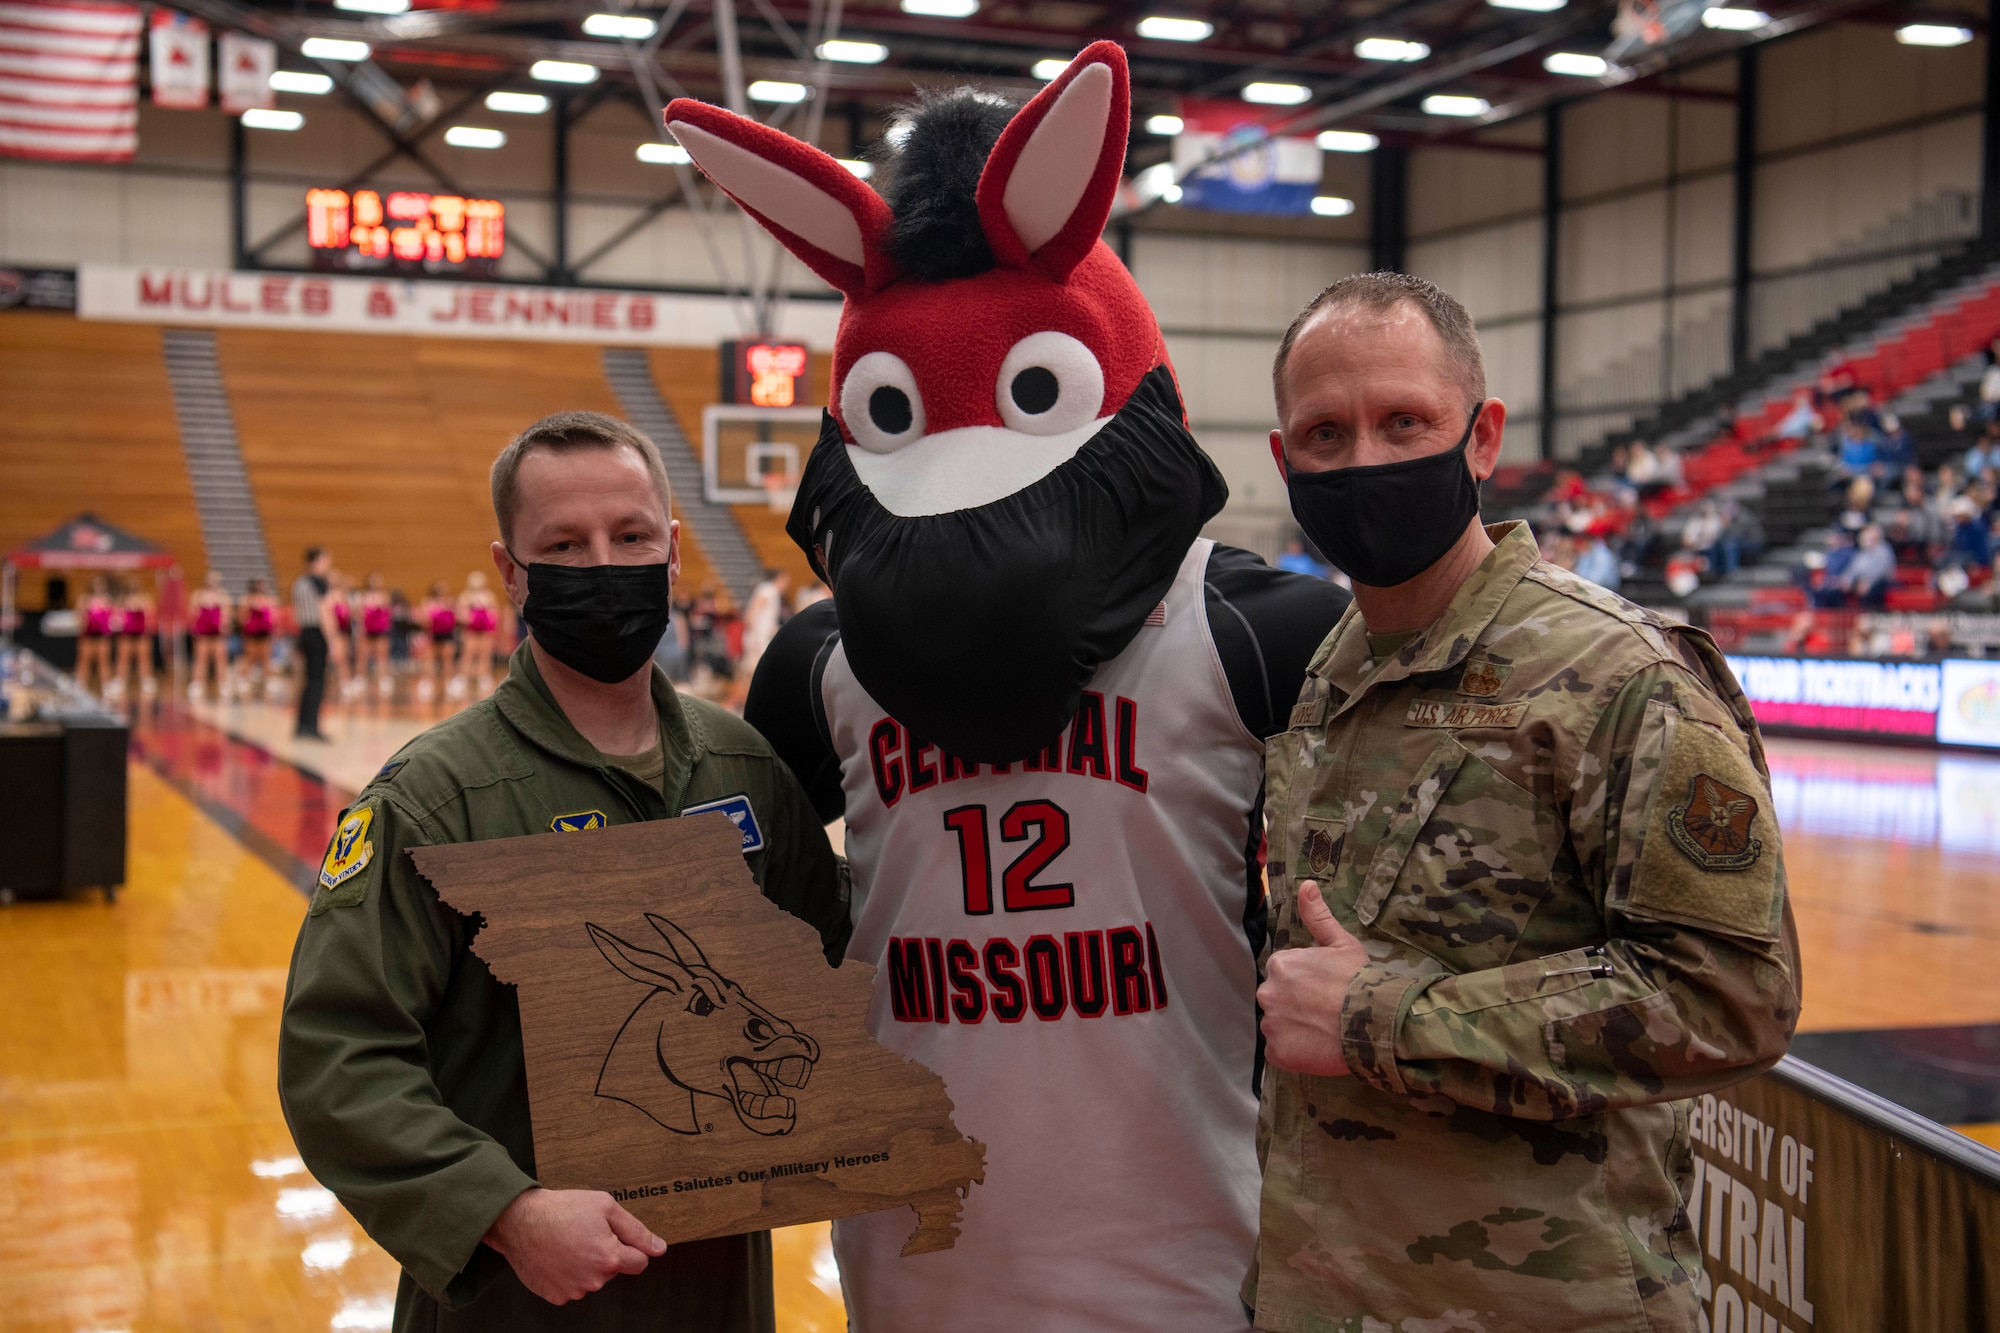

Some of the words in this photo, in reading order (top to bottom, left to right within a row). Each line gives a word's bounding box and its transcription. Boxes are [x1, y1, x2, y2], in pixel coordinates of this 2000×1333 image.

[138, 274, 332, 318] MULES
[366, 284, 396, 319] &
[430, 286, 657, 331] JENNIES
[1414, 702, 1438, 725] U.S.
[1441, 704, 1470, 725] AIR
[1469, 705, 1518, 725] FORCE
[869, 690, 1149, 809] CEAL
[338, 860, 363, 881] VINDEX
[944, 799, 1075, 915] 12
[888, 921, 1168, 1025] MISSOURI
[609, 1185, 668, 1201] hletics
[673, 1174, 733, 1193] Salutes
[737, 1170, 767, 1184] Our
[770, 1158, 829, 1179] Military
[834, 1151, 890, 1169] Heroes
[1780, 1134, 1814, 1205] OF
